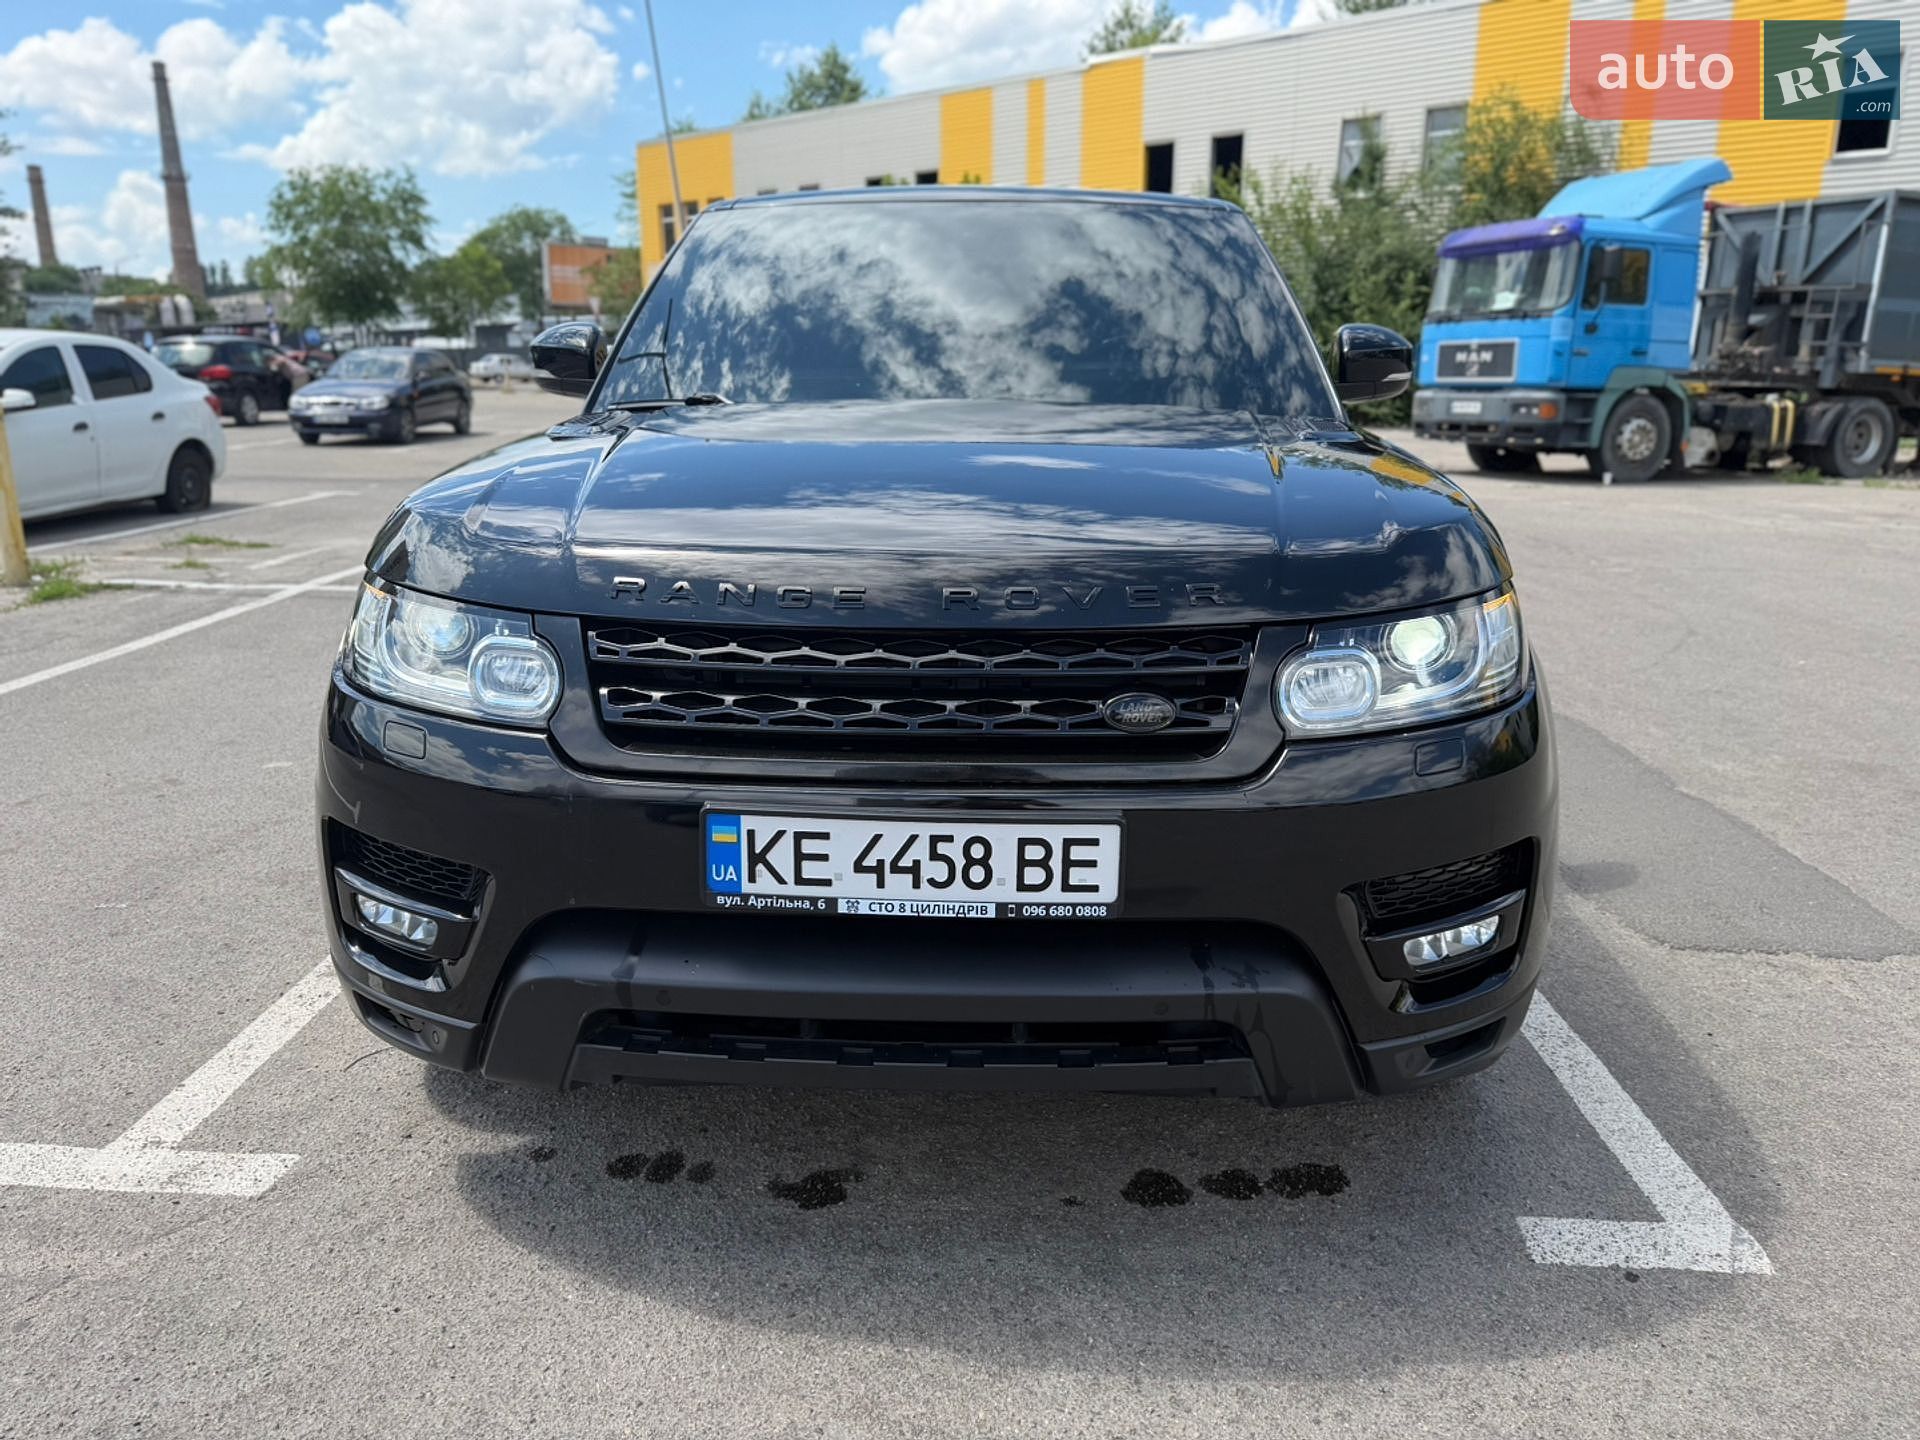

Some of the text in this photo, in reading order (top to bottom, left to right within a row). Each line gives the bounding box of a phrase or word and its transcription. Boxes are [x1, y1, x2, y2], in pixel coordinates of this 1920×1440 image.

[1455, 350, 1494, 363] MAN
[610, 575, 1225, 611] RANGE ROVER
[1120, 702, 1153, 712] LAND
[1122, 713, 1164, 723] ROVER
[746, 829, 1100, 893] KE 4458 BE
[711, 863, 738, 881] UA
[716, 895, 826, 910] вул. Артільна, 6
[868, 902, 988, 917] СТО 8 ЦИЛІНДРІВ
[1022, 905, 1107, 917] 096 680 0808
